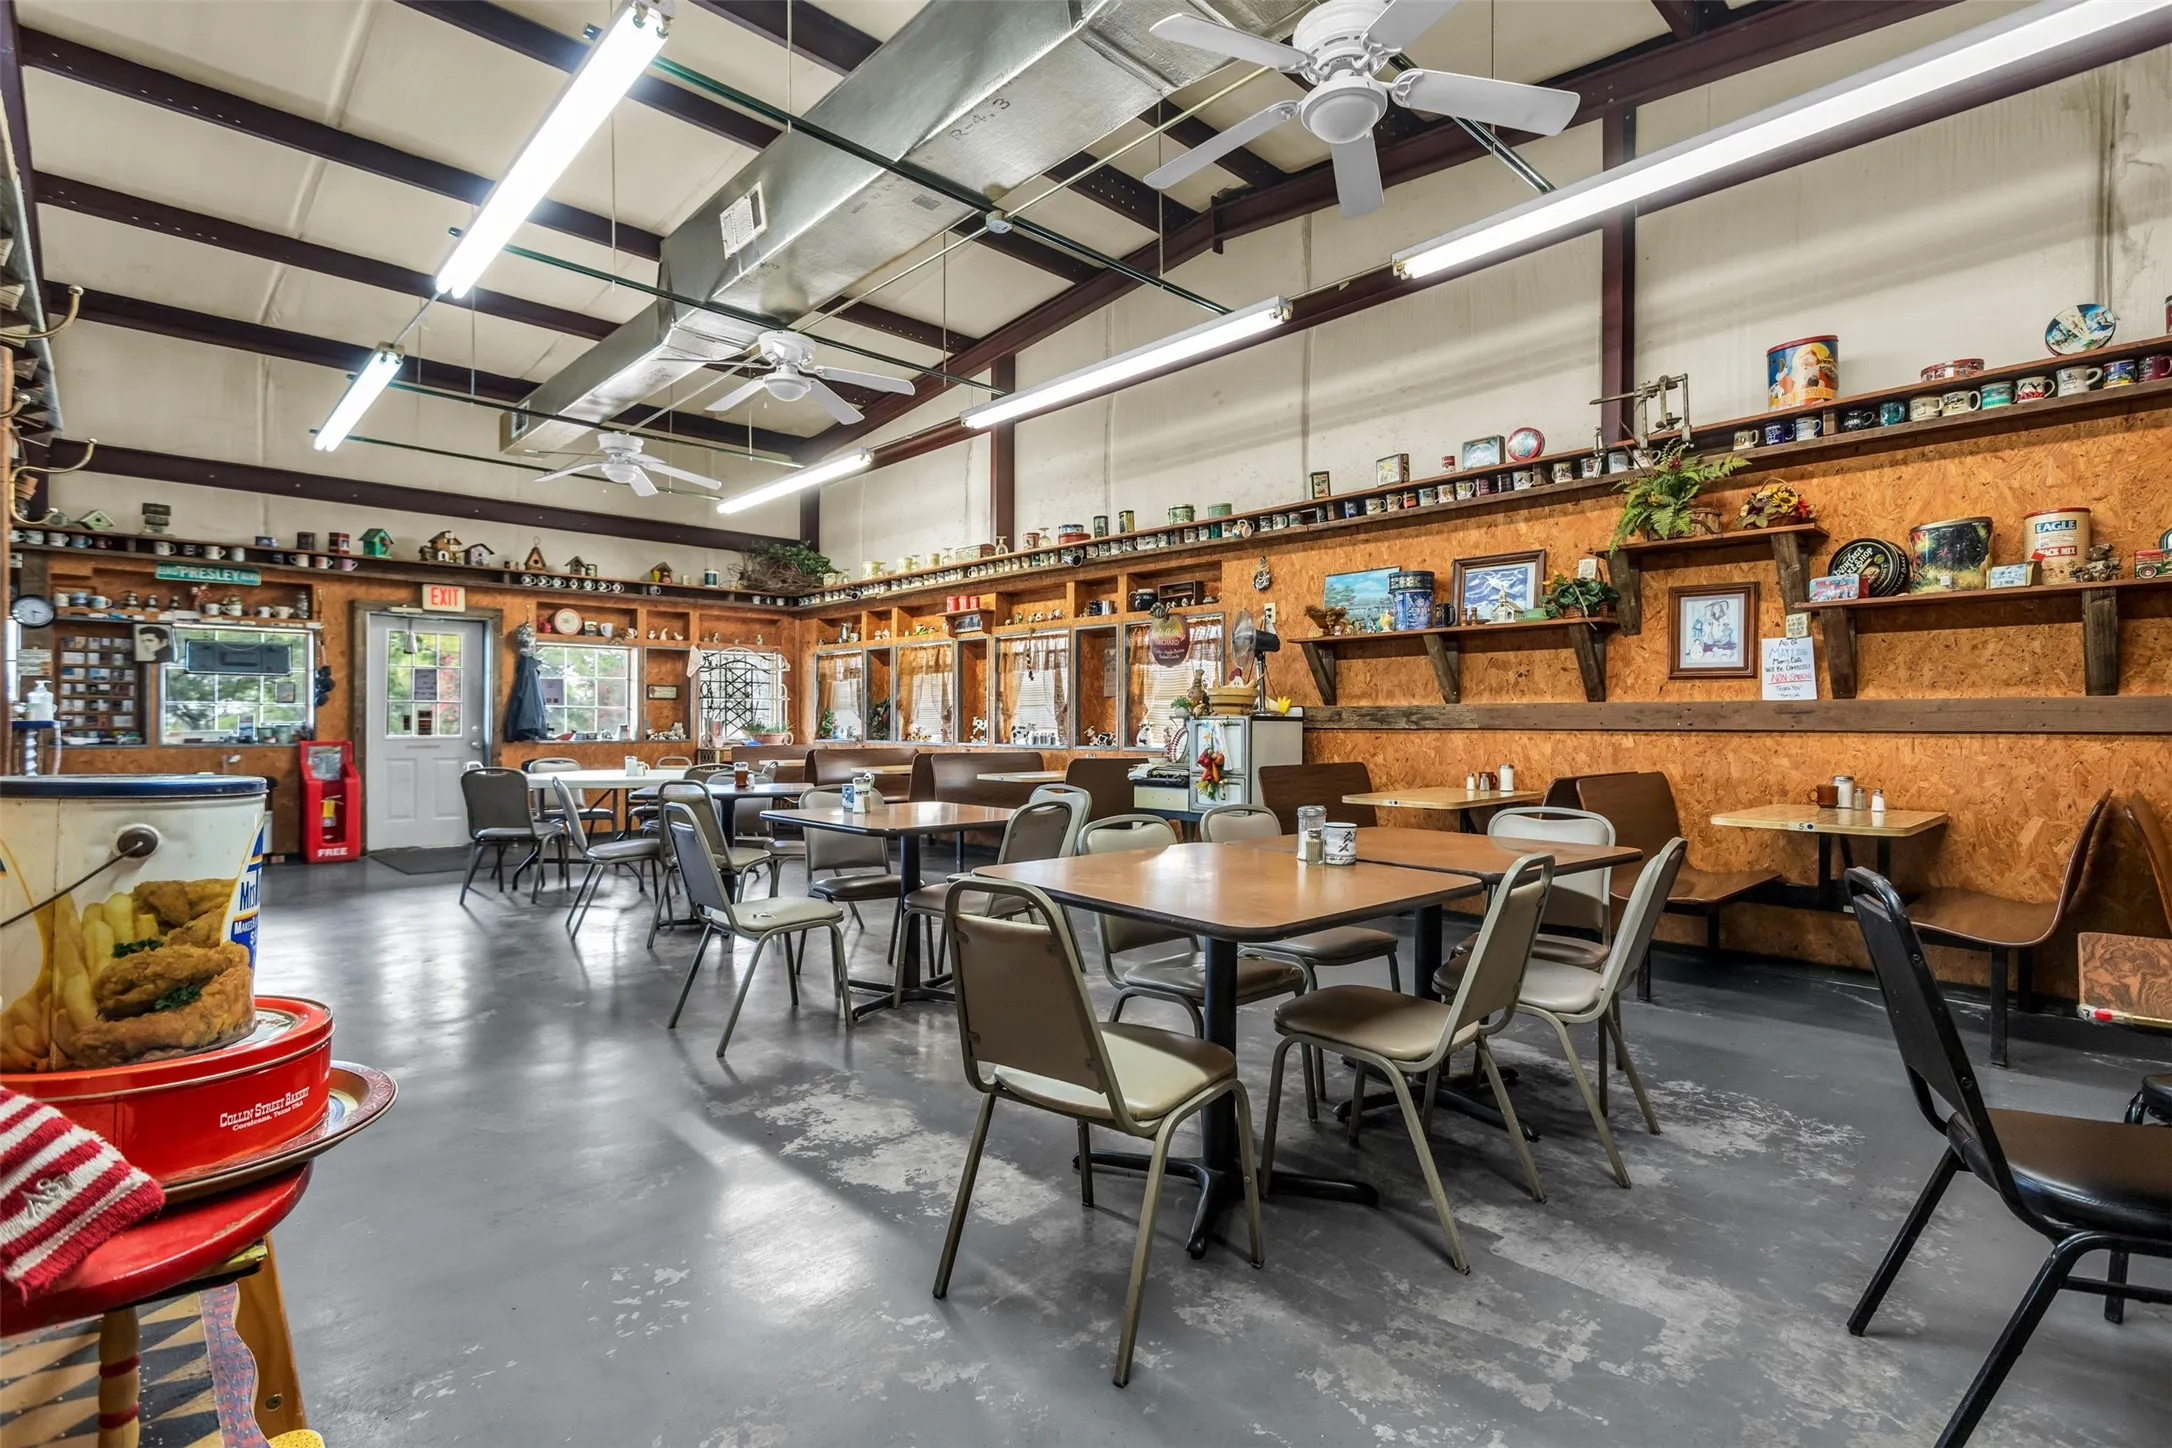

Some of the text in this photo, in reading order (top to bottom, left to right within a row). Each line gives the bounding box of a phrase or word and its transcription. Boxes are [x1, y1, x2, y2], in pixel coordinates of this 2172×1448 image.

[2036, 521, 2075, 532] EAGLE
[1838, 546, 1864, 573] VINTAGE
[1855, 547, 1873, 567] SHOP
[2060, 547, 2076, 555] MIX
[176, 566, 239, 580] PRESLEY
[430, 586, 459, 606] EXIT
[317, 847, 348, 858] FREE
[220, 1086, 310, 1128] COLLIN STREET BAKERY
[232, 1100, 304, 1131] Corsicana, Texas USA
